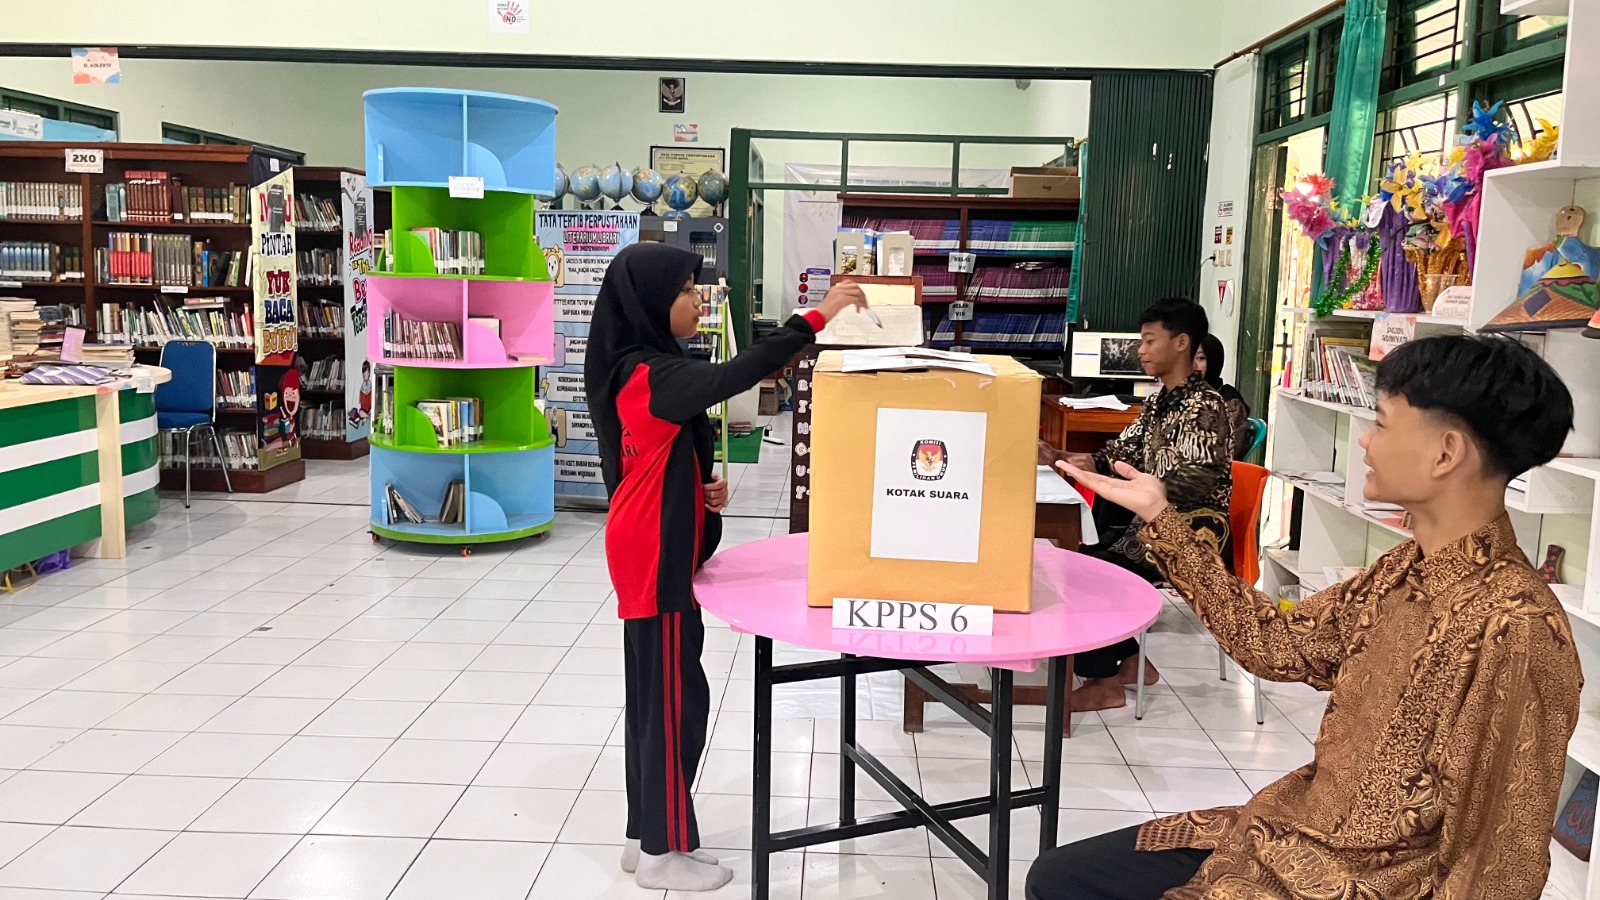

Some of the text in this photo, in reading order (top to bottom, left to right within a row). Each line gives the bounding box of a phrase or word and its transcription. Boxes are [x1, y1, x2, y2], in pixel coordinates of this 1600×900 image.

[539, 214, 638, 229] TATA TERTIB PERPUSTAKAAN
[266, 269, 291, 294] YUK
[353, 279, 367, 302] Be
[264, 298, 294, 324] BACA
[263, 325, 298, 353] BUKU!
[886, 488, 969, 500] KOTAK SUARA
[846, 600, 969, 632] KPPS 6
